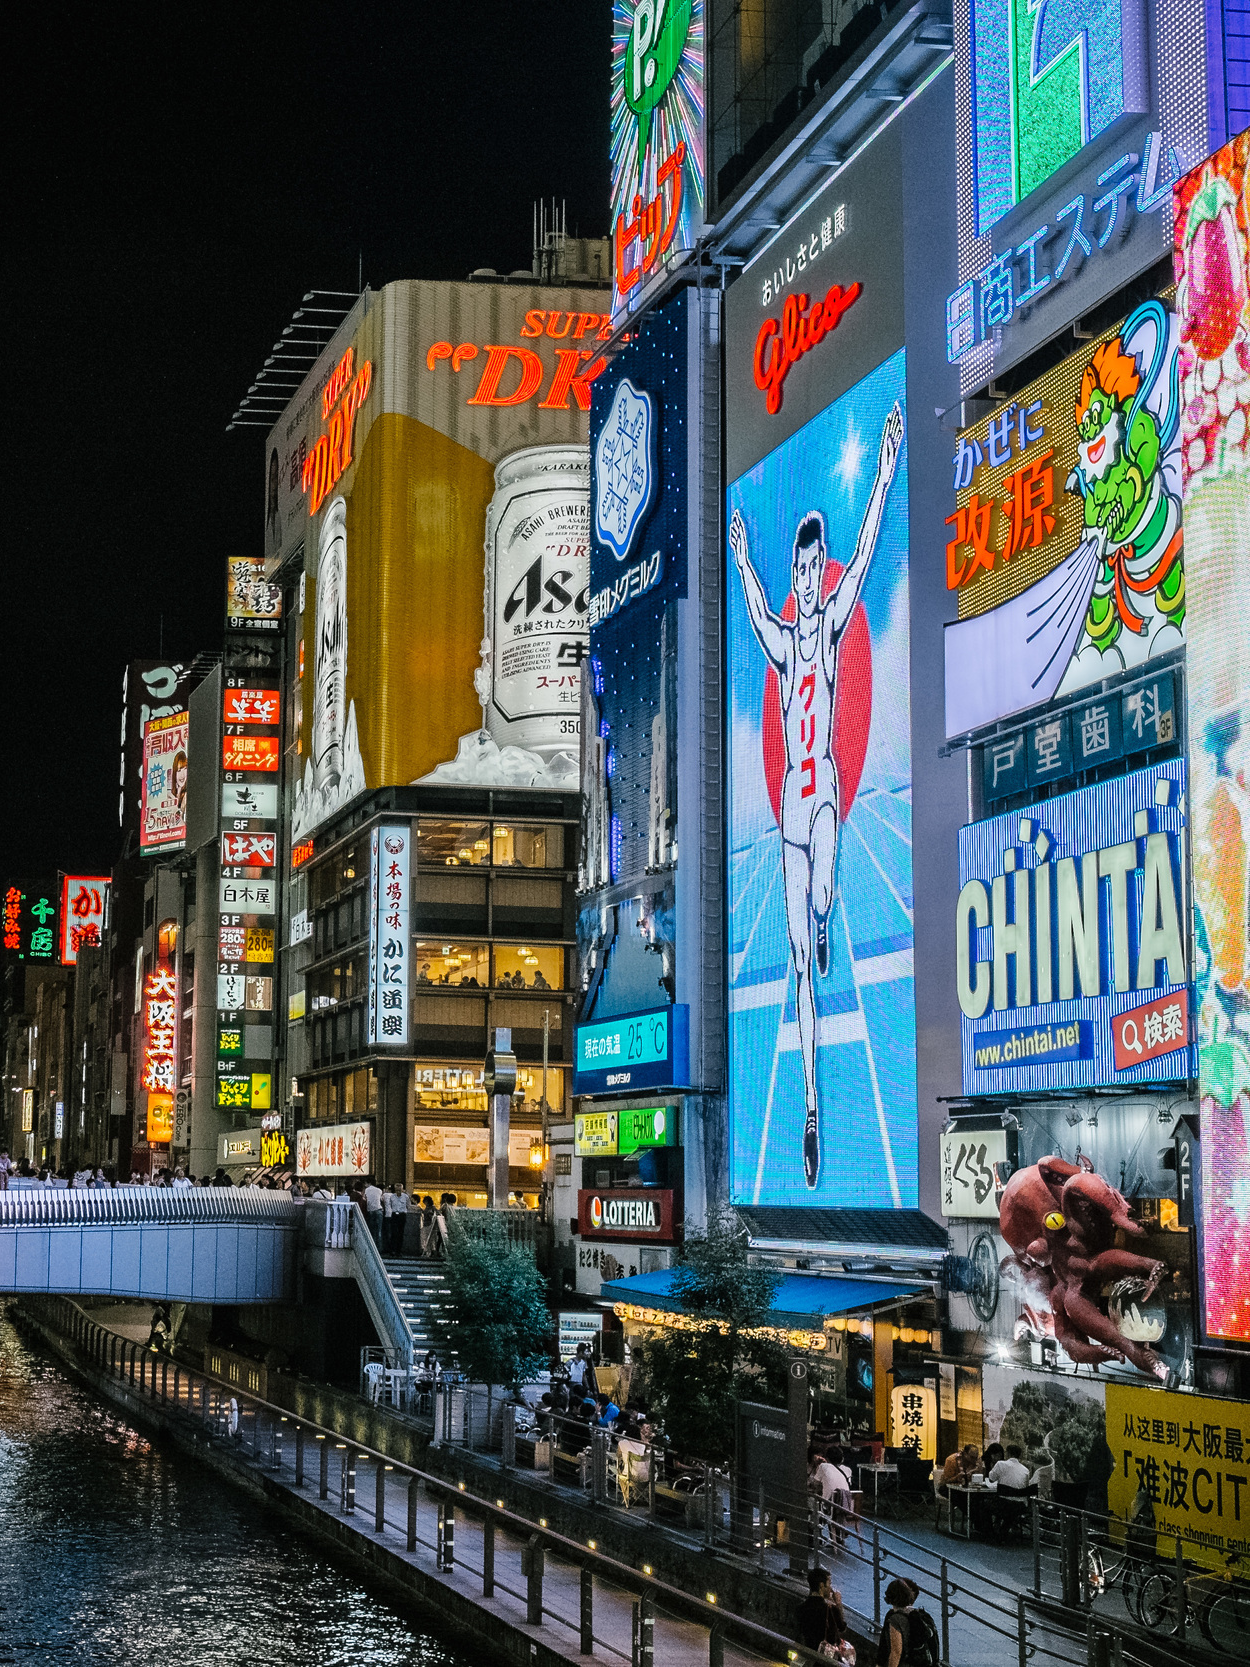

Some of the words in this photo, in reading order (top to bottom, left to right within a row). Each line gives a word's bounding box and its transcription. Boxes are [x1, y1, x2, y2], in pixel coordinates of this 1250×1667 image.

[616, 140, 686, 295] ピップ
[762, 203, 846, 306] おいしさと健康
[946, 131, 1181, 363] 日商エステム
[754, 281, 862, 415] Glico
[321, 346, 354, 420] SUPER
[952, 401, 1045, 490] かぜに
[521, 515, 545, 541] ASAHI
[944, 448, 1058, 591] 改源
[588, 550, 661, 627] 雪印メグミルク
[230, 616, 244, 627] 9F
[227, 678, 245, 687] 8F
[226, 725, 244, 735] 7F
[798, 663, 817, 799] グリコ
[992, 683, 1162, 788] 戸堂歯科
[232, 739, 255, 752] 相席
[225, 752, 277, 767] ダイニング
[225, 772, 243, 782] 6F
[233, 820, 248, 830] 5F
[222, 867, 241, 877] 4F
[223, 885, 271, 903] 白木屋
[385, 861, 403, 930] 本場の味
[31, 898, 55, 951] 千房
[221, 915, 240, 925] 3F
[220, 933, 245, 944] 280円
[247, 936, 273, 951] 280円
[219, 963, 239, 973] 2F
[382, 938, 404, 1036] かに道楽
[147, 969, 177, 1091] 大阪王将
[1144, 1003, 1183, 1049] 検索
[584, 1034, 621, 1058] 現在の気温
[627, 1022, 643, 1060] 25
[217, 1060, 236, 1071] B1F
[218, 1093, 250, 1106] ドンキー
[220, 1081, 249, 1094] びっくり
[176, 1103, 185, 1126] ZERO
[1180, 1141, 1190, 1200] 2F
[603, 1200, 656, 1227] LOTTERIA
[1123, 1412, 1250, 1465] 从这里到大阪最
